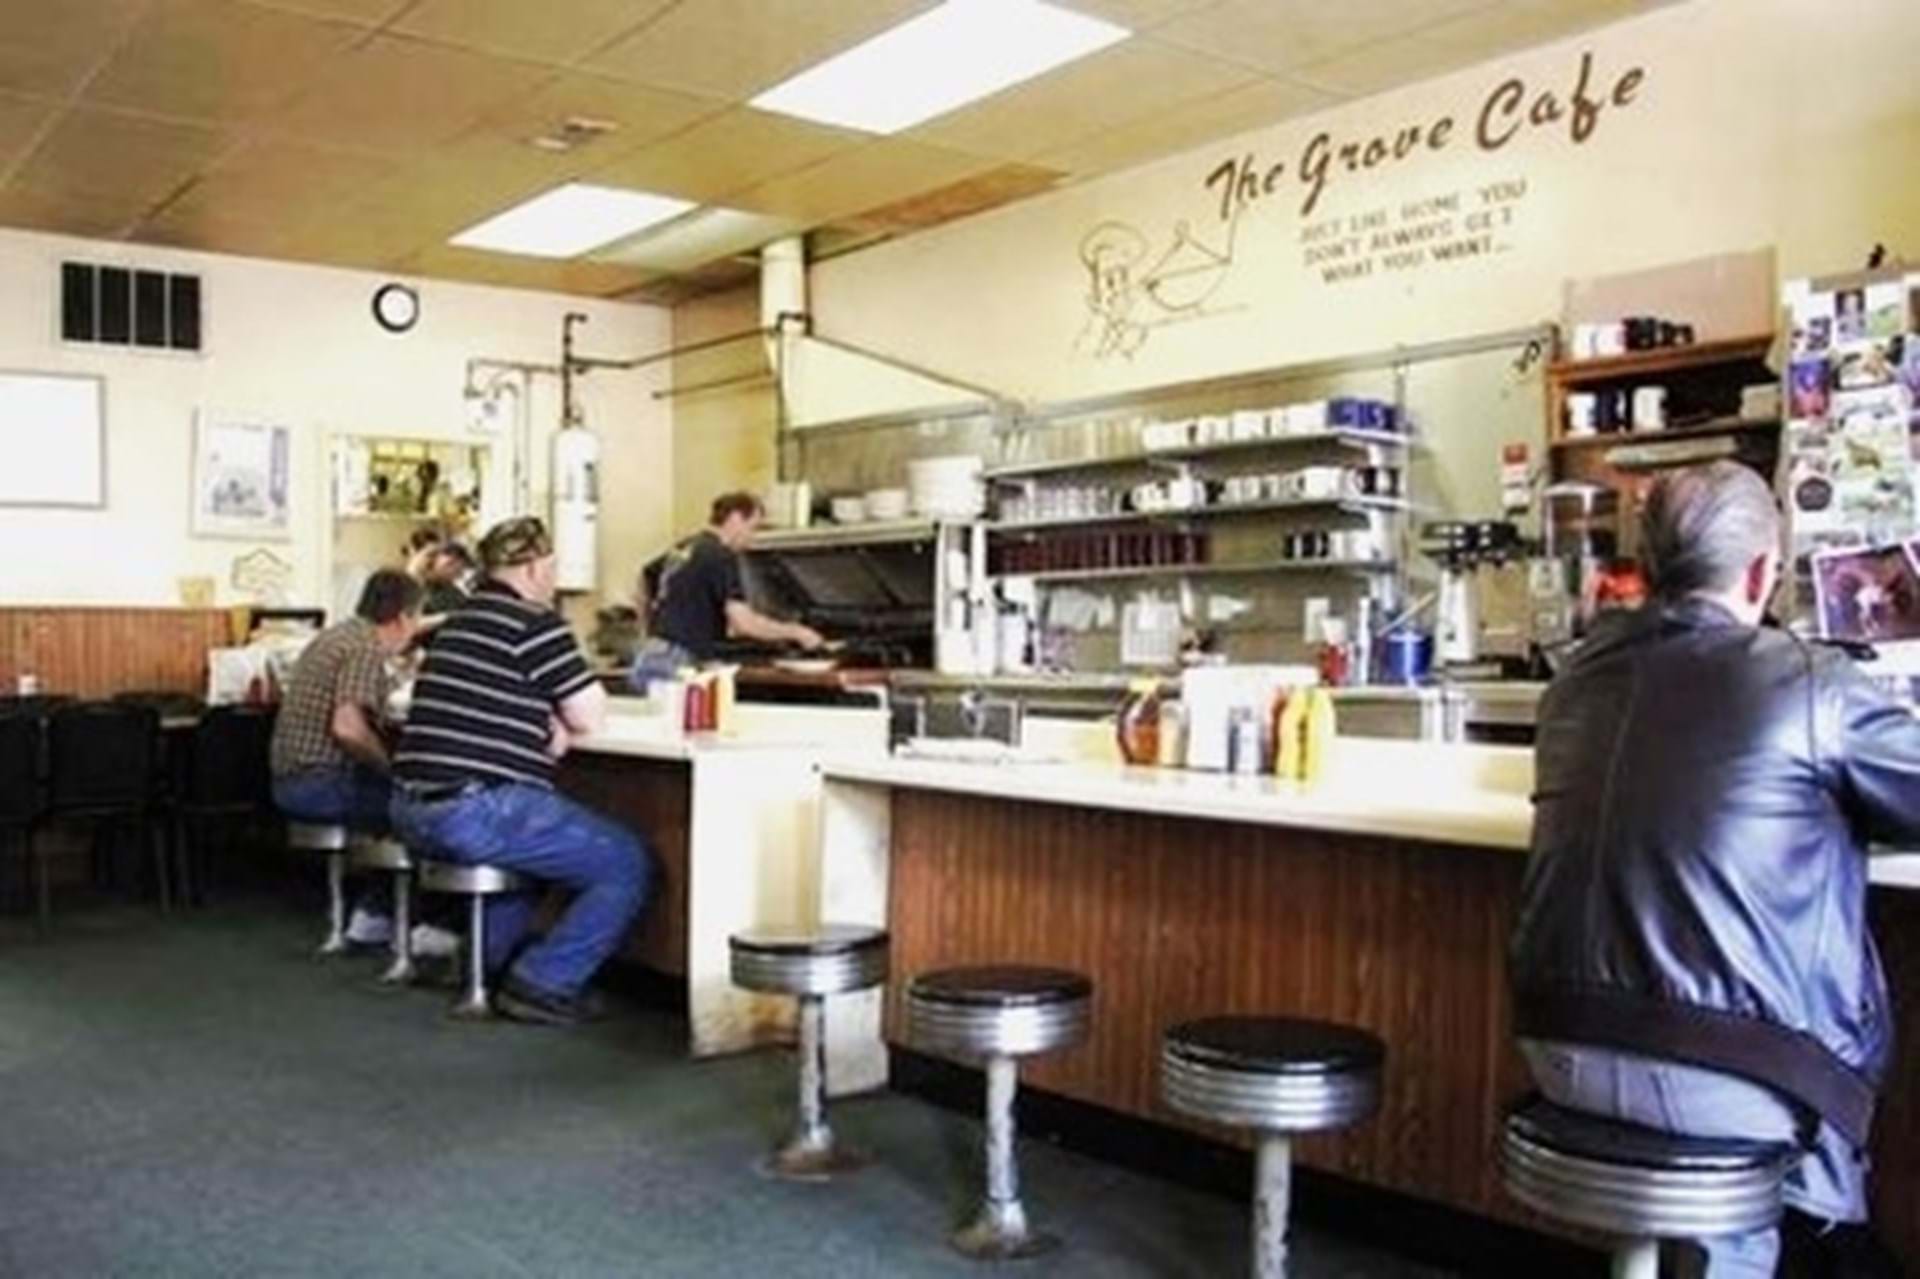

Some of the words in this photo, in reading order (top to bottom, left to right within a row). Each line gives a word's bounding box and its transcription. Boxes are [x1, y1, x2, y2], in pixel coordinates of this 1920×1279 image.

[1205, 154, 1283, 219] The
[1299, 117, 1453, 216] Grove
[1476, 53, 1644, 151] Cafe
[1478, 178, 1526, 203] YOU
[1304, 238, 1359, 266] DON'T
[1371, 219, 1452, 249] ALWAYS
[1322, 258, 1372, 283] WHAT
[1383, 248, 1425, 270] YOU
